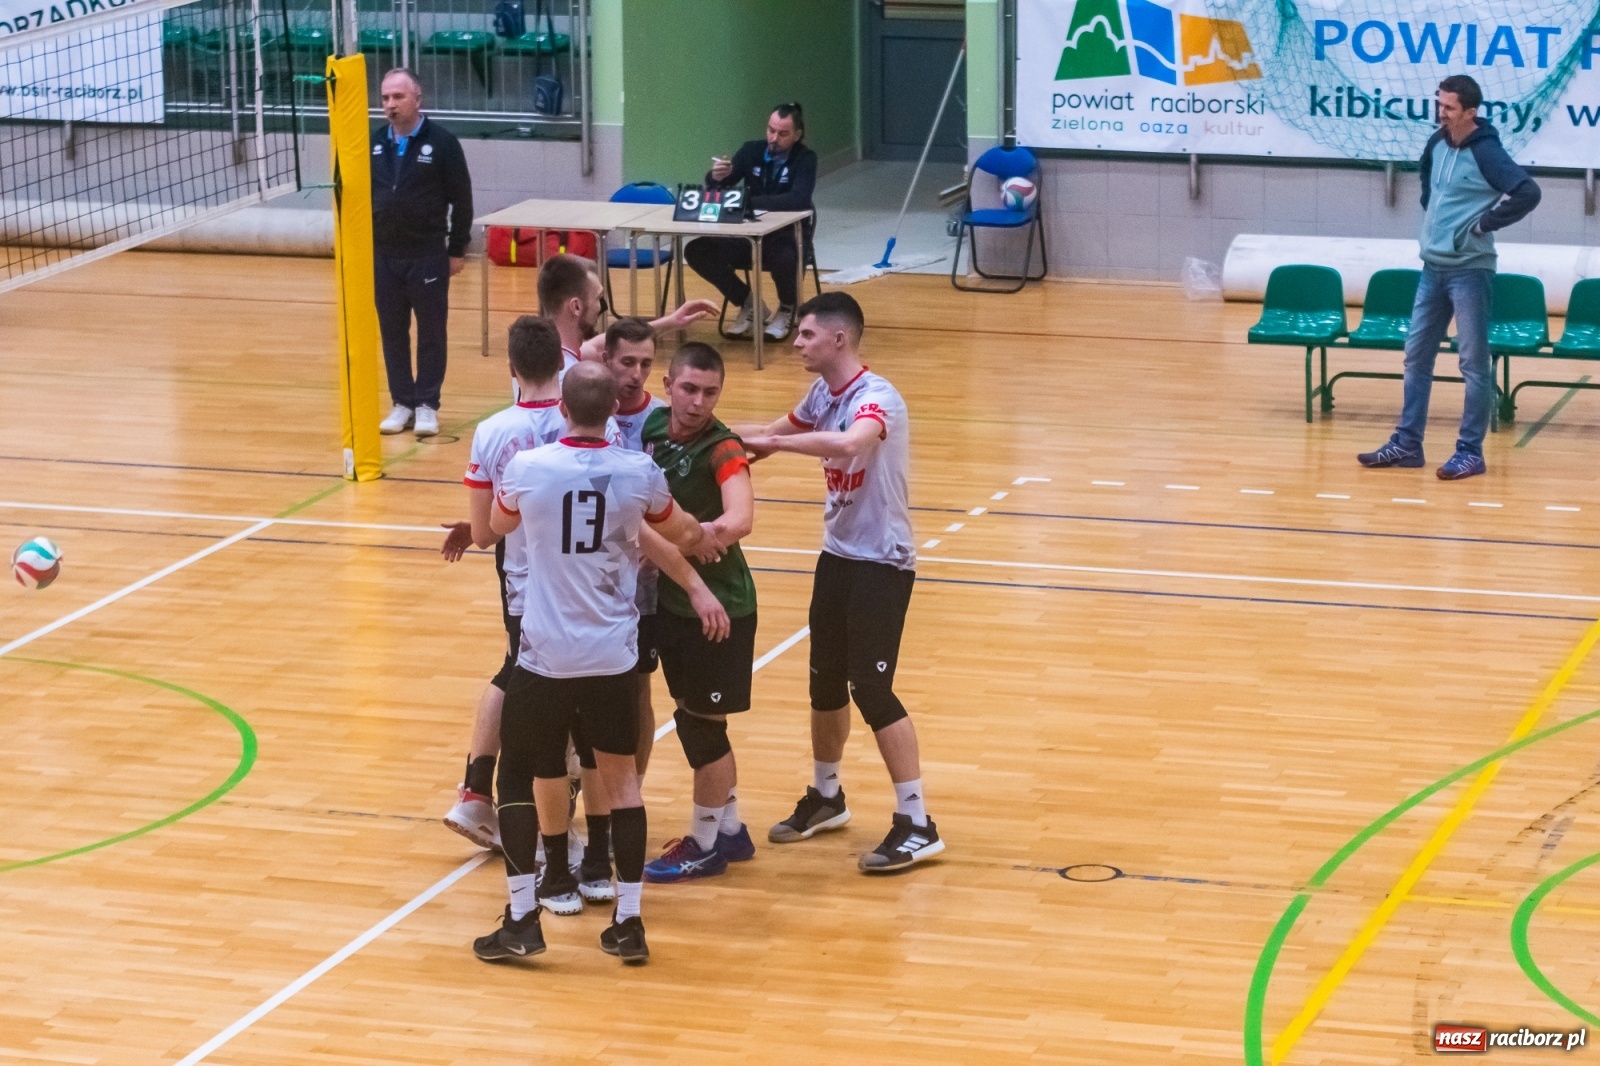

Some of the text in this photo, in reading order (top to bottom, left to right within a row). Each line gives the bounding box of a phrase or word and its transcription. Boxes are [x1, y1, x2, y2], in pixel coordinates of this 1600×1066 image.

[1314, 19, 1562, 69] POWIAT
[1052, 89, 1265, 115] powiat raciborski
[1310, 85, 1542, 133] kibicujmy,
[1052, 116, 1265, 137] zielona oaza kultur
[681, 190, 700, 210] 3
[723, 190, 742, 208] 2
[561, 489, 606, 555] 13
